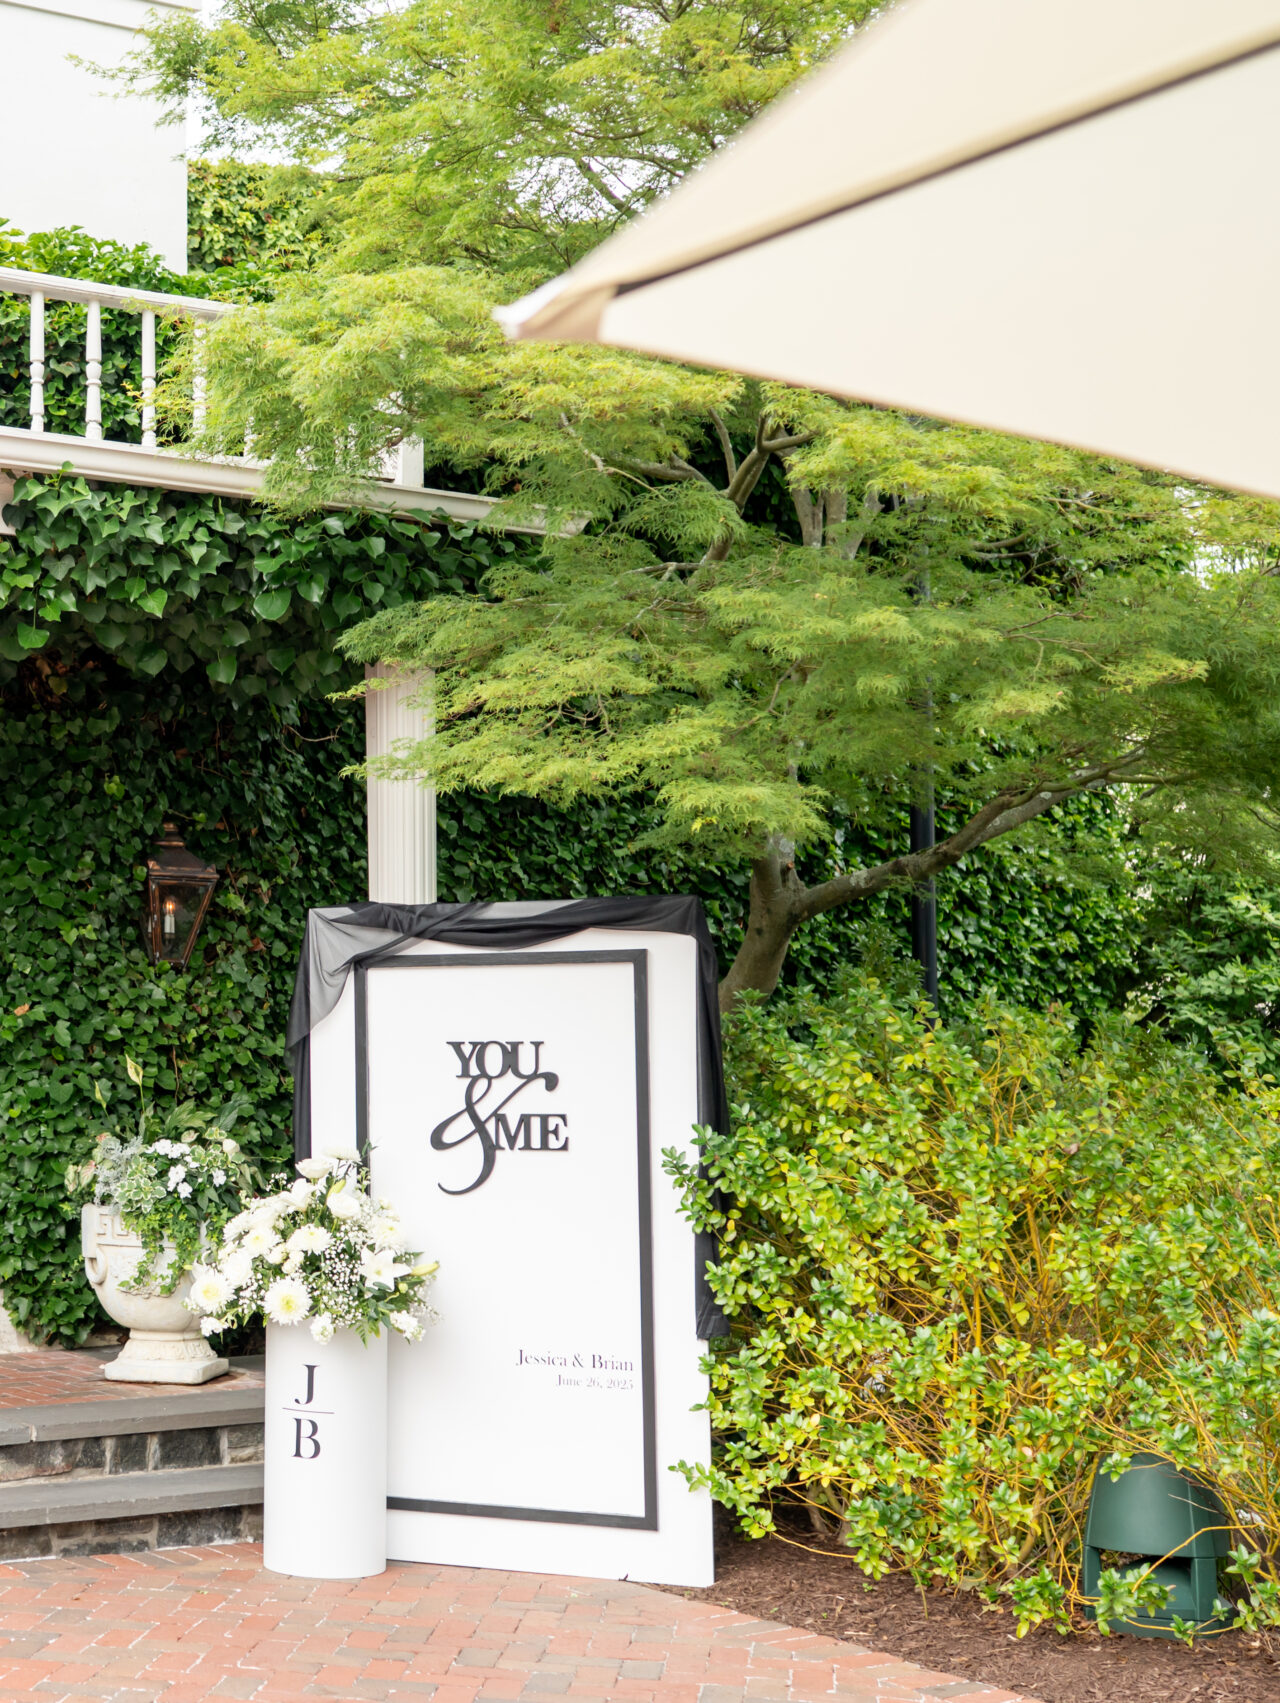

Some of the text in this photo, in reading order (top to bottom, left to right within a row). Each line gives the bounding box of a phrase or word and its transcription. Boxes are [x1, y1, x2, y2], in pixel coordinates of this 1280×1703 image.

[446, 1040, 545, 1079] YOU
[430, 1071, 569, 1195] & ME
[515, 1349, 633, 1371] Jessica & Brian
[556, 1374, 581, 1386] June
[294, 1364, 320, 1405] J
[291, 1417, 321, 1459] B
